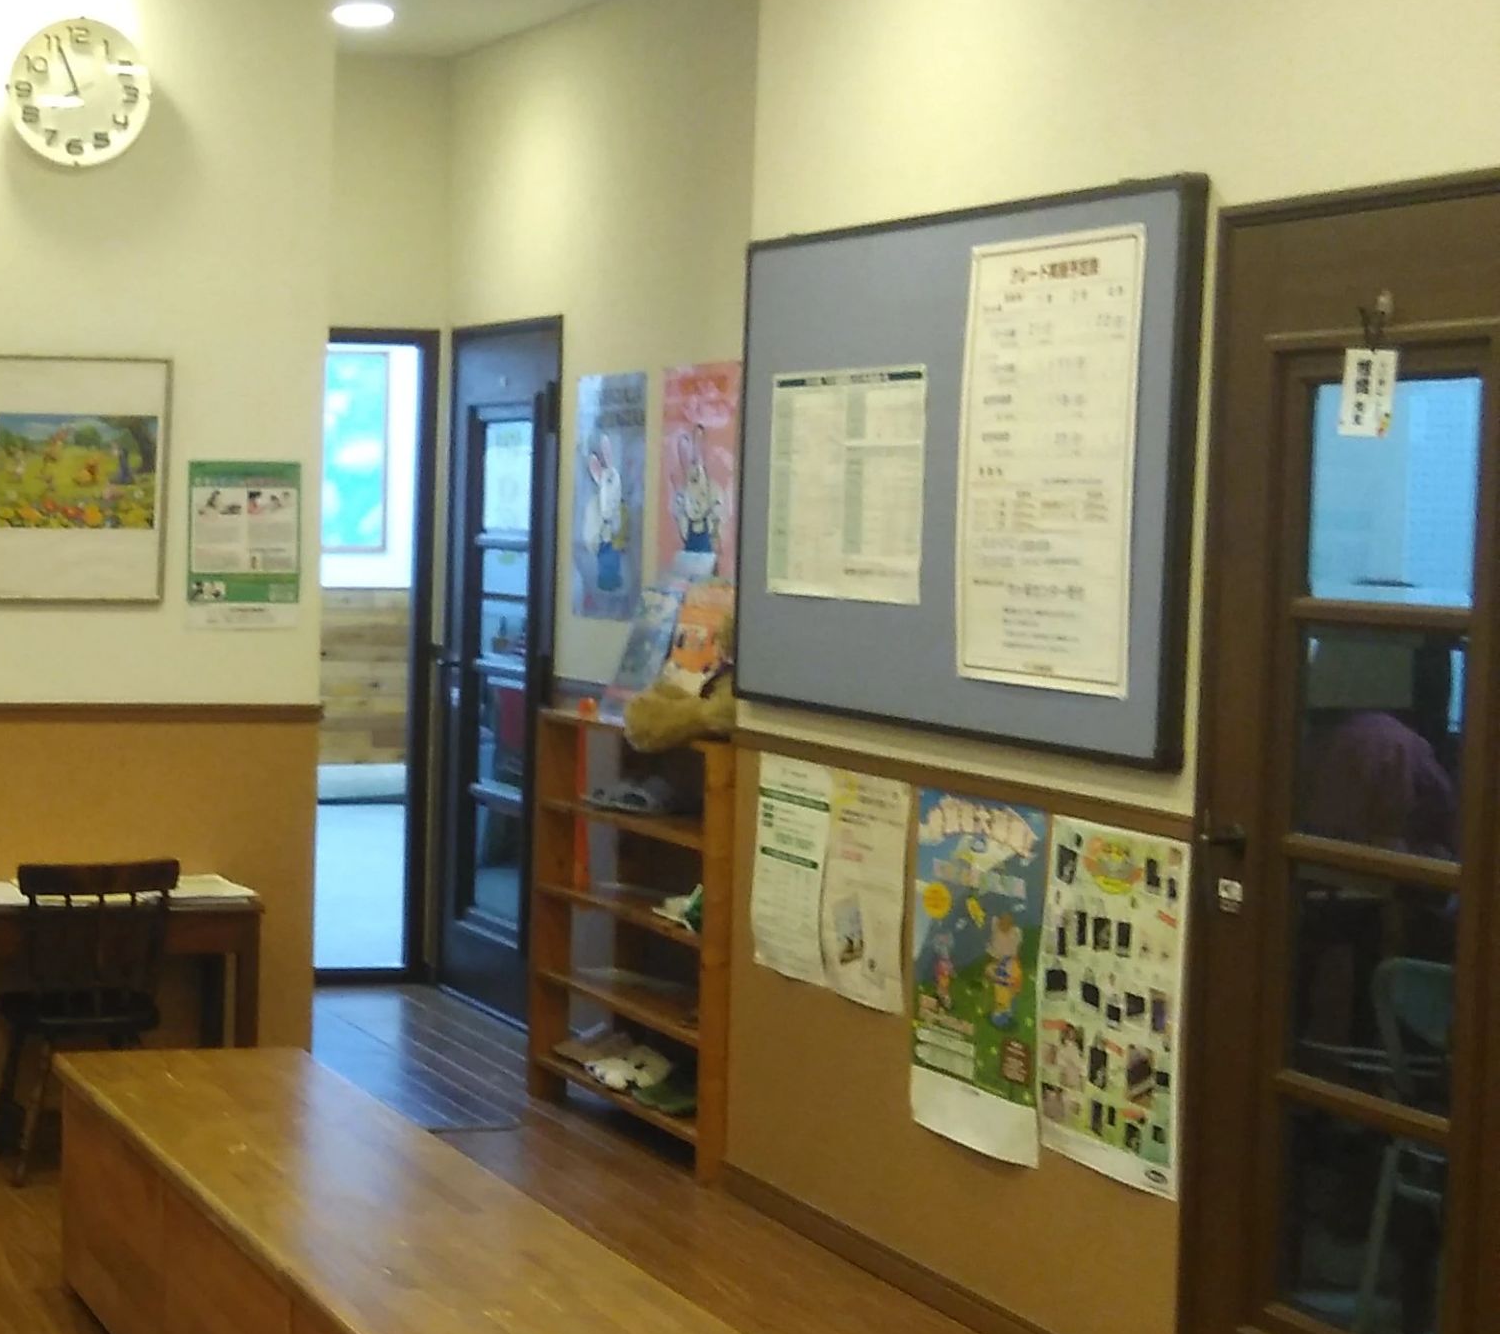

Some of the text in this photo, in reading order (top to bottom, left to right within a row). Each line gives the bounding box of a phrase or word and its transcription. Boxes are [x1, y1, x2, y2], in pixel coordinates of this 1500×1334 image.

[44, 33, 61, 53] 11
[66, 26, 90, 44] 12
[103, 38, 110, 55] 1
[24, 55, 48, 74] 10
[15, 80, 32, 98] 9
[123, 84, 139, 104] 3
[22, 105, 40, 123] 8
[112, 114, 129, 130] 4
[44, 128, 58, 146] 7
[93, 132, 110, 149] 5
[65, 138, 84, 155] 6
